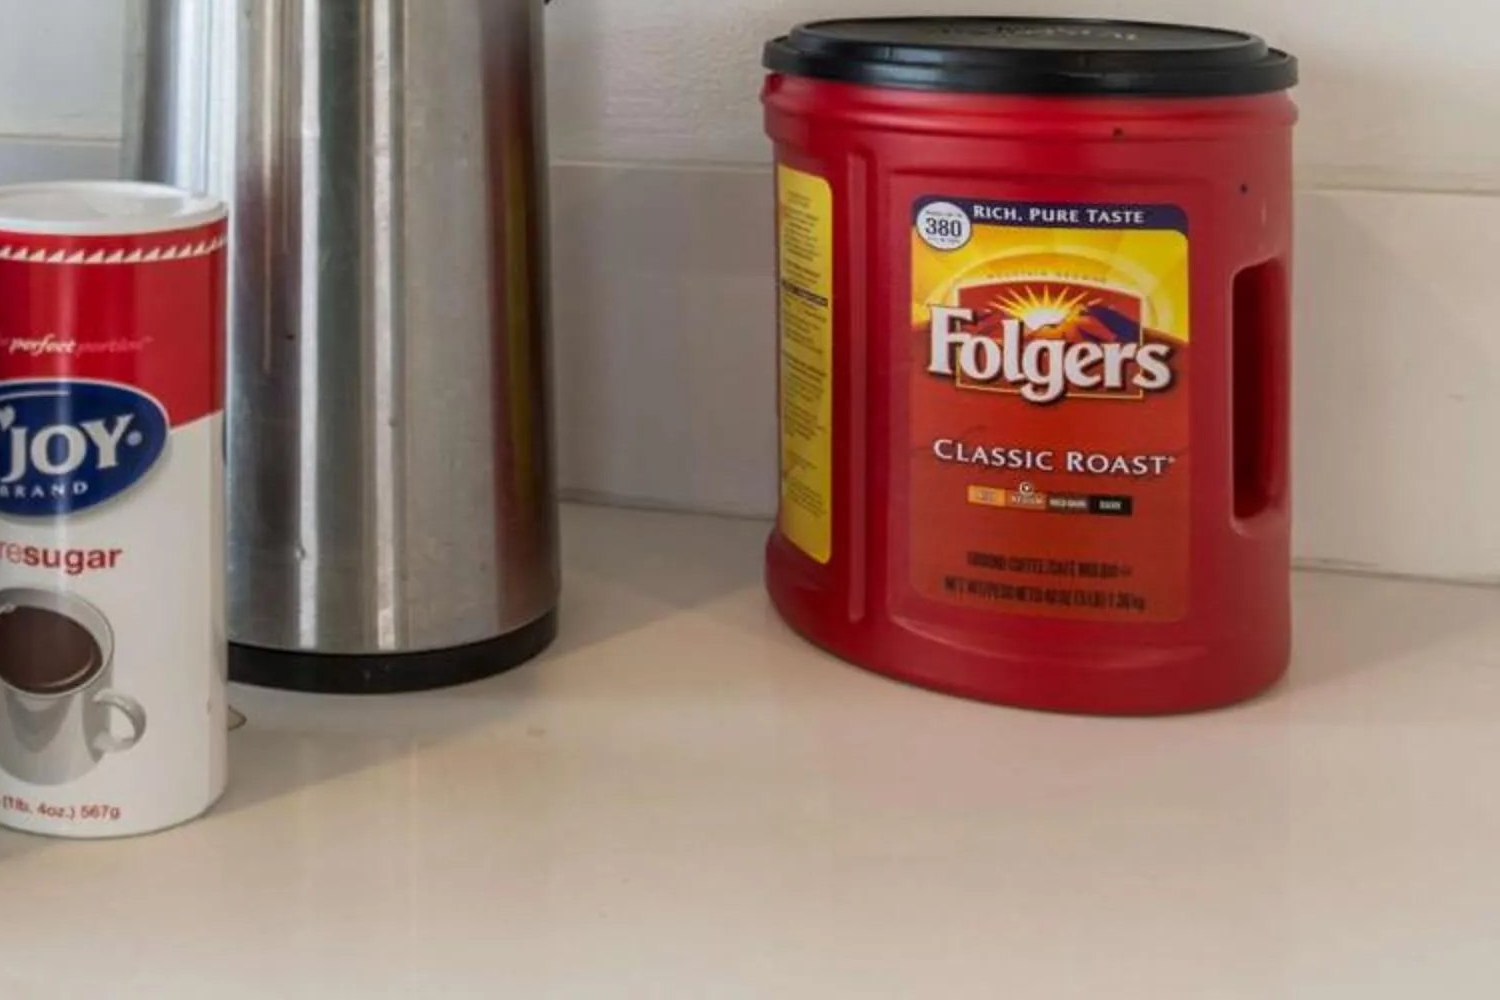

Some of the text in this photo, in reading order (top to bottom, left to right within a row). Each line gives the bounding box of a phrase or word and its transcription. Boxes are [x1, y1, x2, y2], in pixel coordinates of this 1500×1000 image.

[1029, 205, 1079, 223] PURE
[1087, 207, 1145, 224] TASTE
[926, 217, 962, 237] 380
[9, 334, 77, 356] perfect
[928, 305, 1172, 402] Folgers
[933, 438, 1054, 472] CLASSIC
[79, 804, 121, 821] 567g
